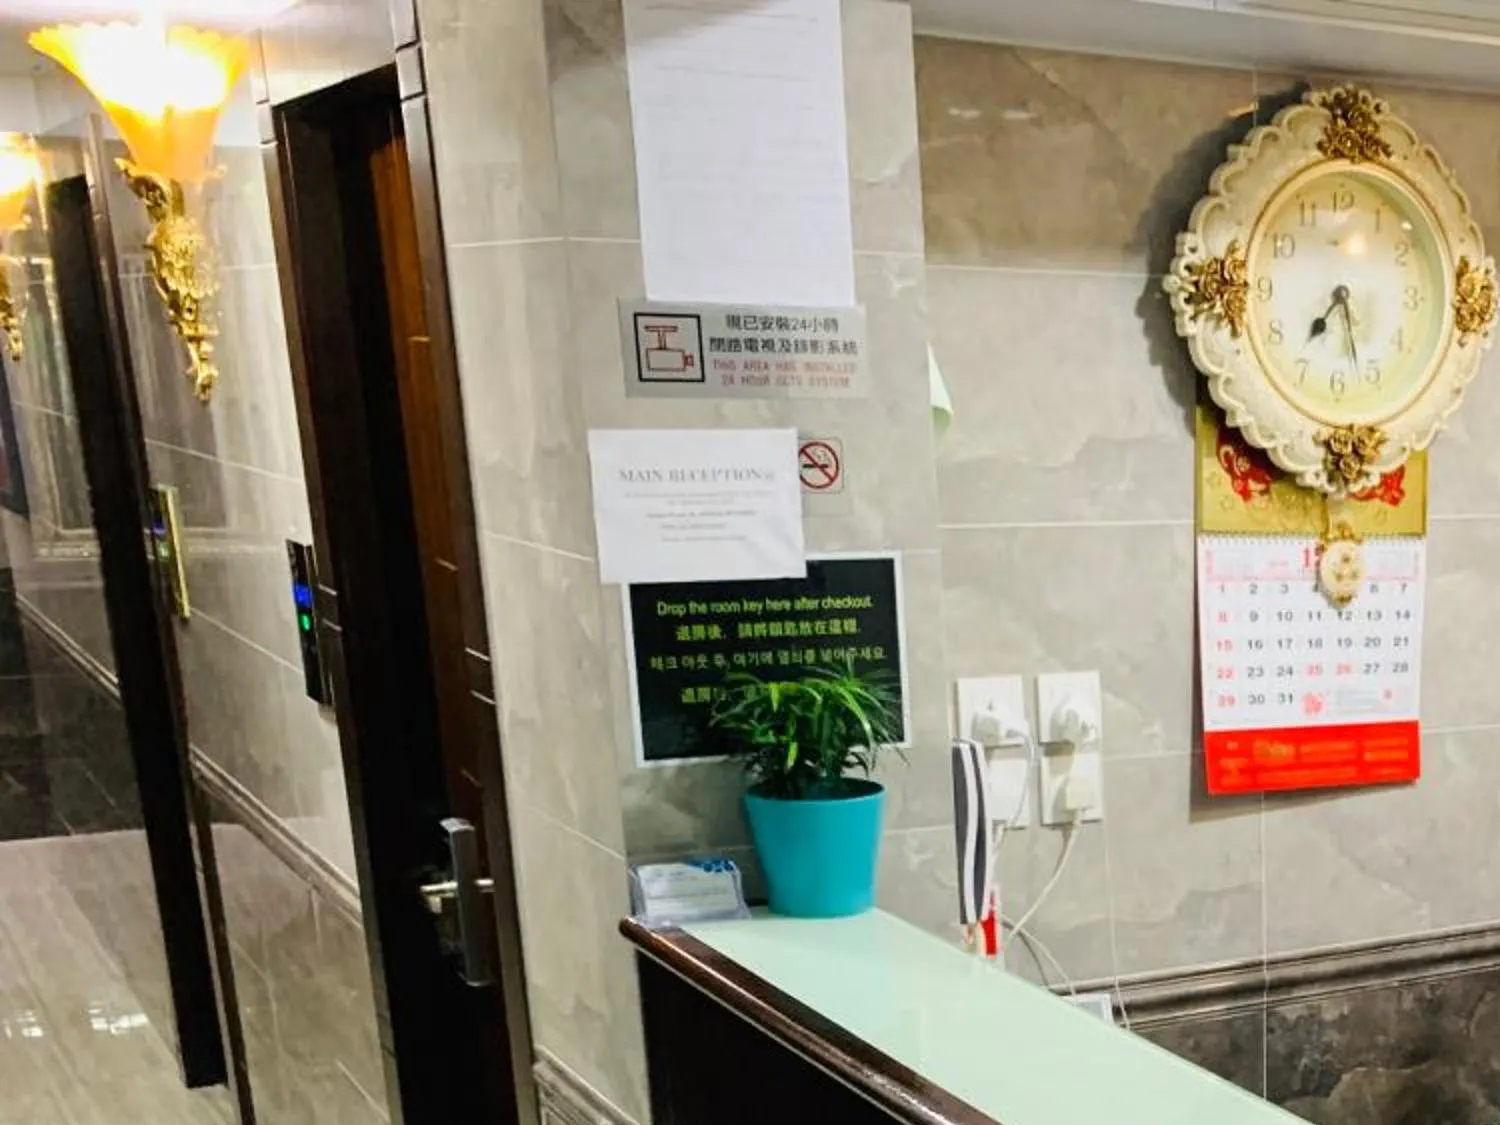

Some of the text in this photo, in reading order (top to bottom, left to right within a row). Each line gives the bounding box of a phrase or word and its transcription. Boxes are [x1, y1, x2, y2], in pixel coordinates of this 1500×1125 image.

[1333, 191, 1354, 213] 12
[1300, 201, 1317, 227] 11
[1273, 233, 1295, 259] 10
[1395, 241, 1409, 267] 2
[1257, 276, 1273, 301] 9
[1404, 285, 1419, 311] 3
[1268, 319, 1284, 345] 8
[743, 359, 769, 371] AREA
[1296, 358, 1310, 385] 7
[1365, 360, 1381, 385] 5
[1330, 371, 1345, 396] 6
[619, 467, 663, 483] MAIN
[1249, 583, 1258, 594] 2
[657, 600, 687, 618] Drop
[688, 600, 708, 615] the
[710, 601, 740, 614] room
[743, 598, 763, 616] key
[765, 597, 792, 611] here
[794, 596, 819, 611] after
[1249, 612, 1259, 623] 9
[1277, 612, 1293, 622] 10
[1308, 611, 1322, 621] 11
[1337, 611, 1352, 621] 12
[1367, 611, 1382, 621] 13
[1396, 611, 1410, 620] 14
[1217, 637, 1409, 651] 15 16 17 18 19 20 21
[733, 650, 773, 667] 여기에
[1217, 662, 1409, 679] 22 23 24 25 26 27 28
[1218, 696, 1235, 707] 29
[1248, 694, 1265, 705] 30
[1277, 693, 1294, 704] 31
